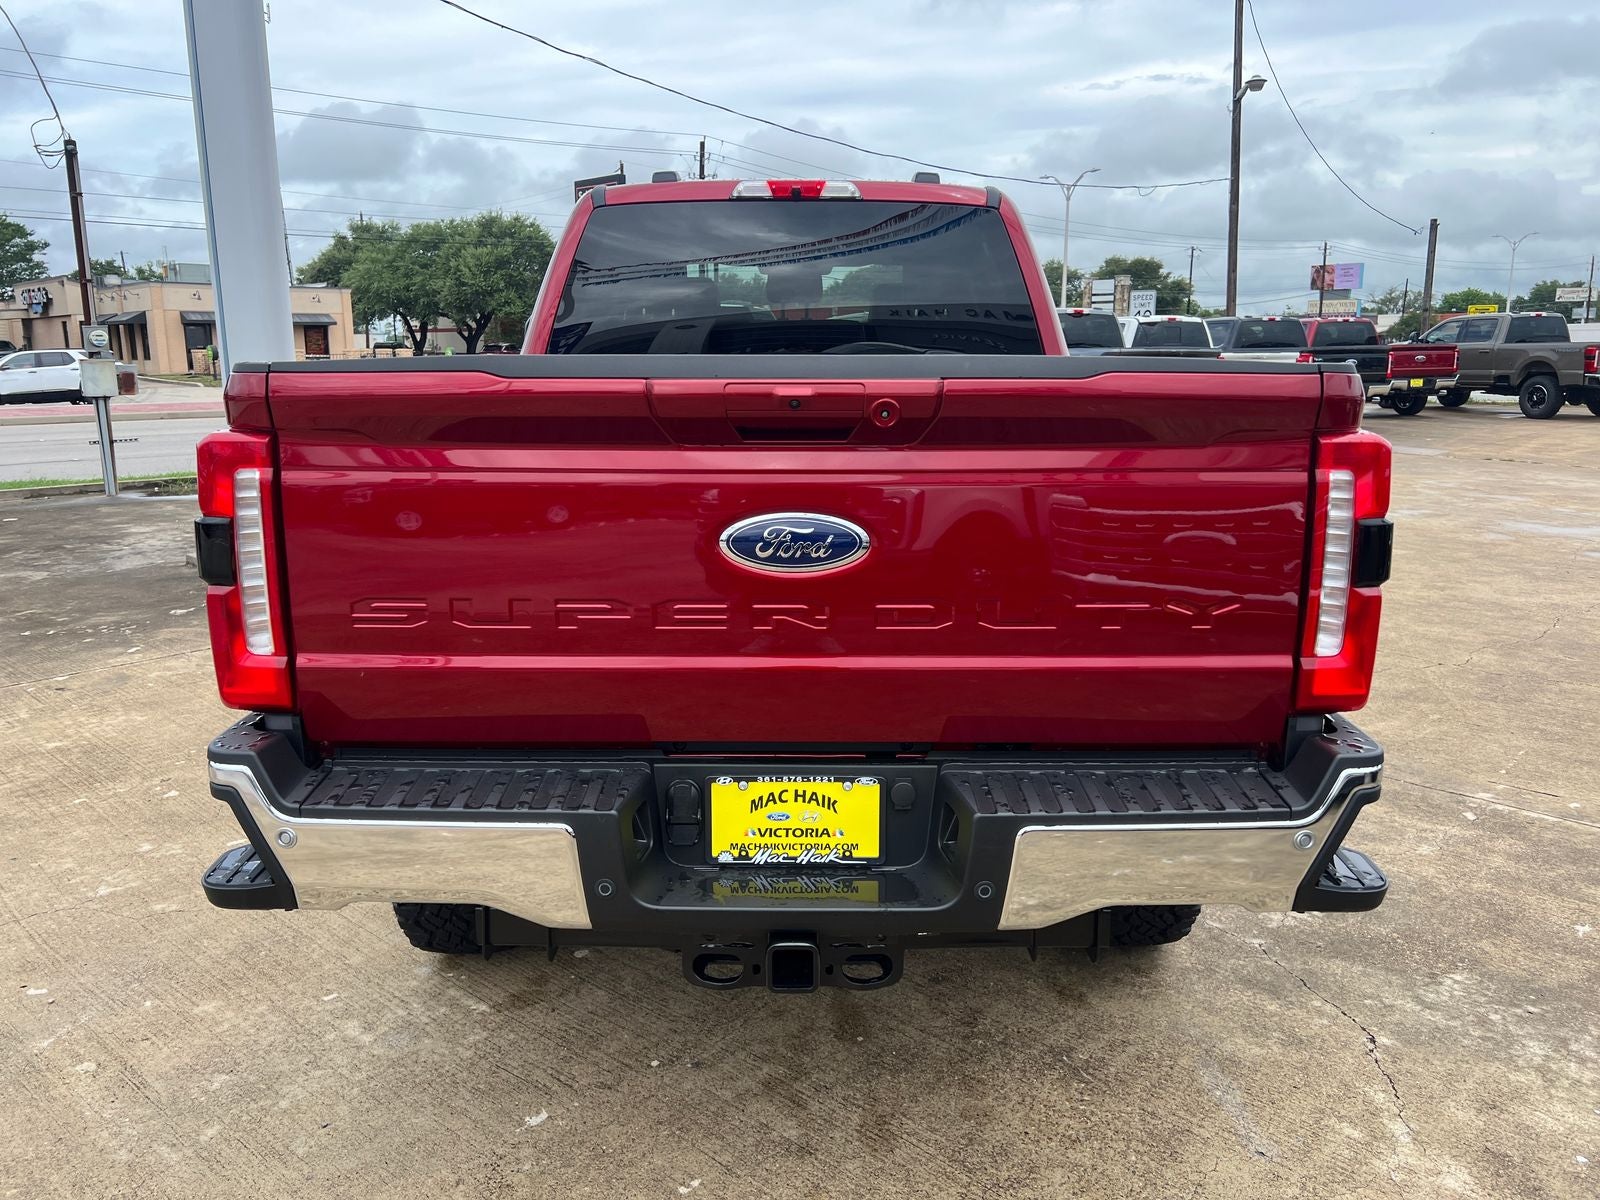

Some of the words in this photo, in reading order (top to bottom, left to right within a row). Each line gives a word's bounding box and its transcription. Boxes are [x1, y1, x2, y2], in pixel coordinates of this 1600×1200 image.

[755, 525, 835, 558] Ford
[349, 598, 830, 630] SUPER
[873, 600, 1242, 630] DUTY
[750, 789, 790, 813] MAC
[794, 789, 838, 814] HAIK
[757, 827, 831, 838] VICTORIA
[730, 842, 859, 850] MACHAIKVICTORIACOM
[751, 846, 795, 864] Mac
[796, 846, 842, 864] Haik
